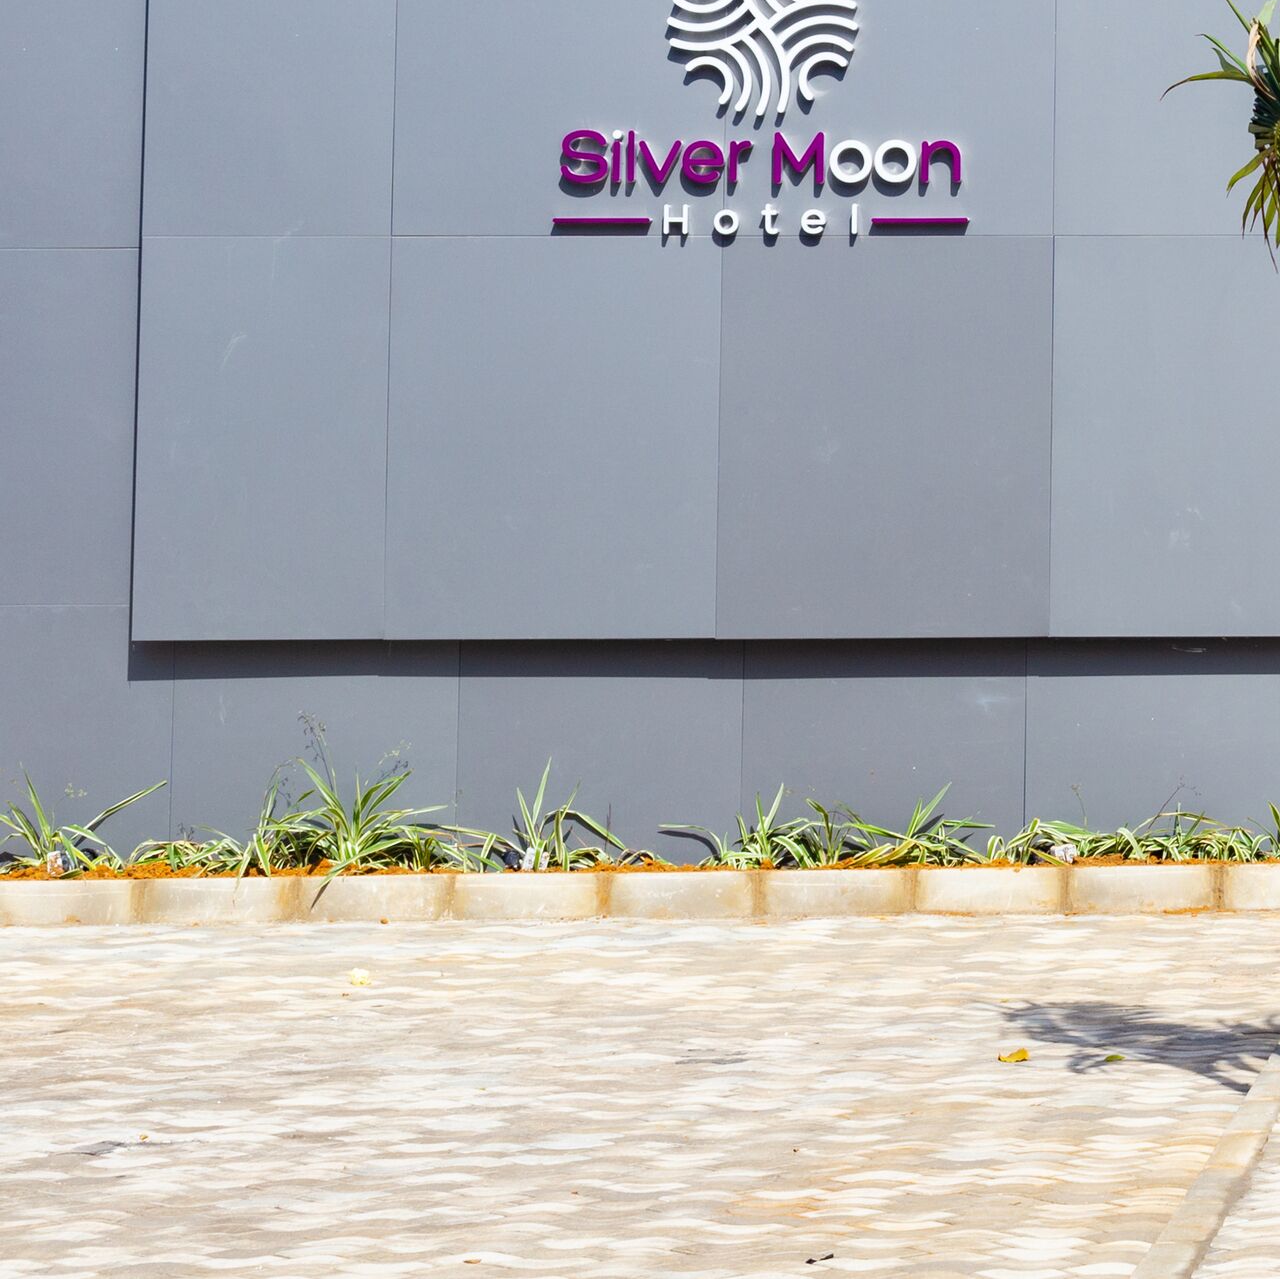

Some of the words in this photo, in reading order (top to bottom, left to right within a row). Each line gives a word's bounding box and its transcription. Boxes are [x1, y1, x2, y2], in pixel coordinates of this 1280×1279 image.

[560, 129, 752, 184] Silver
[772, 131, 962, 185] Moon
[662, 203, 859, 236] Hotel
